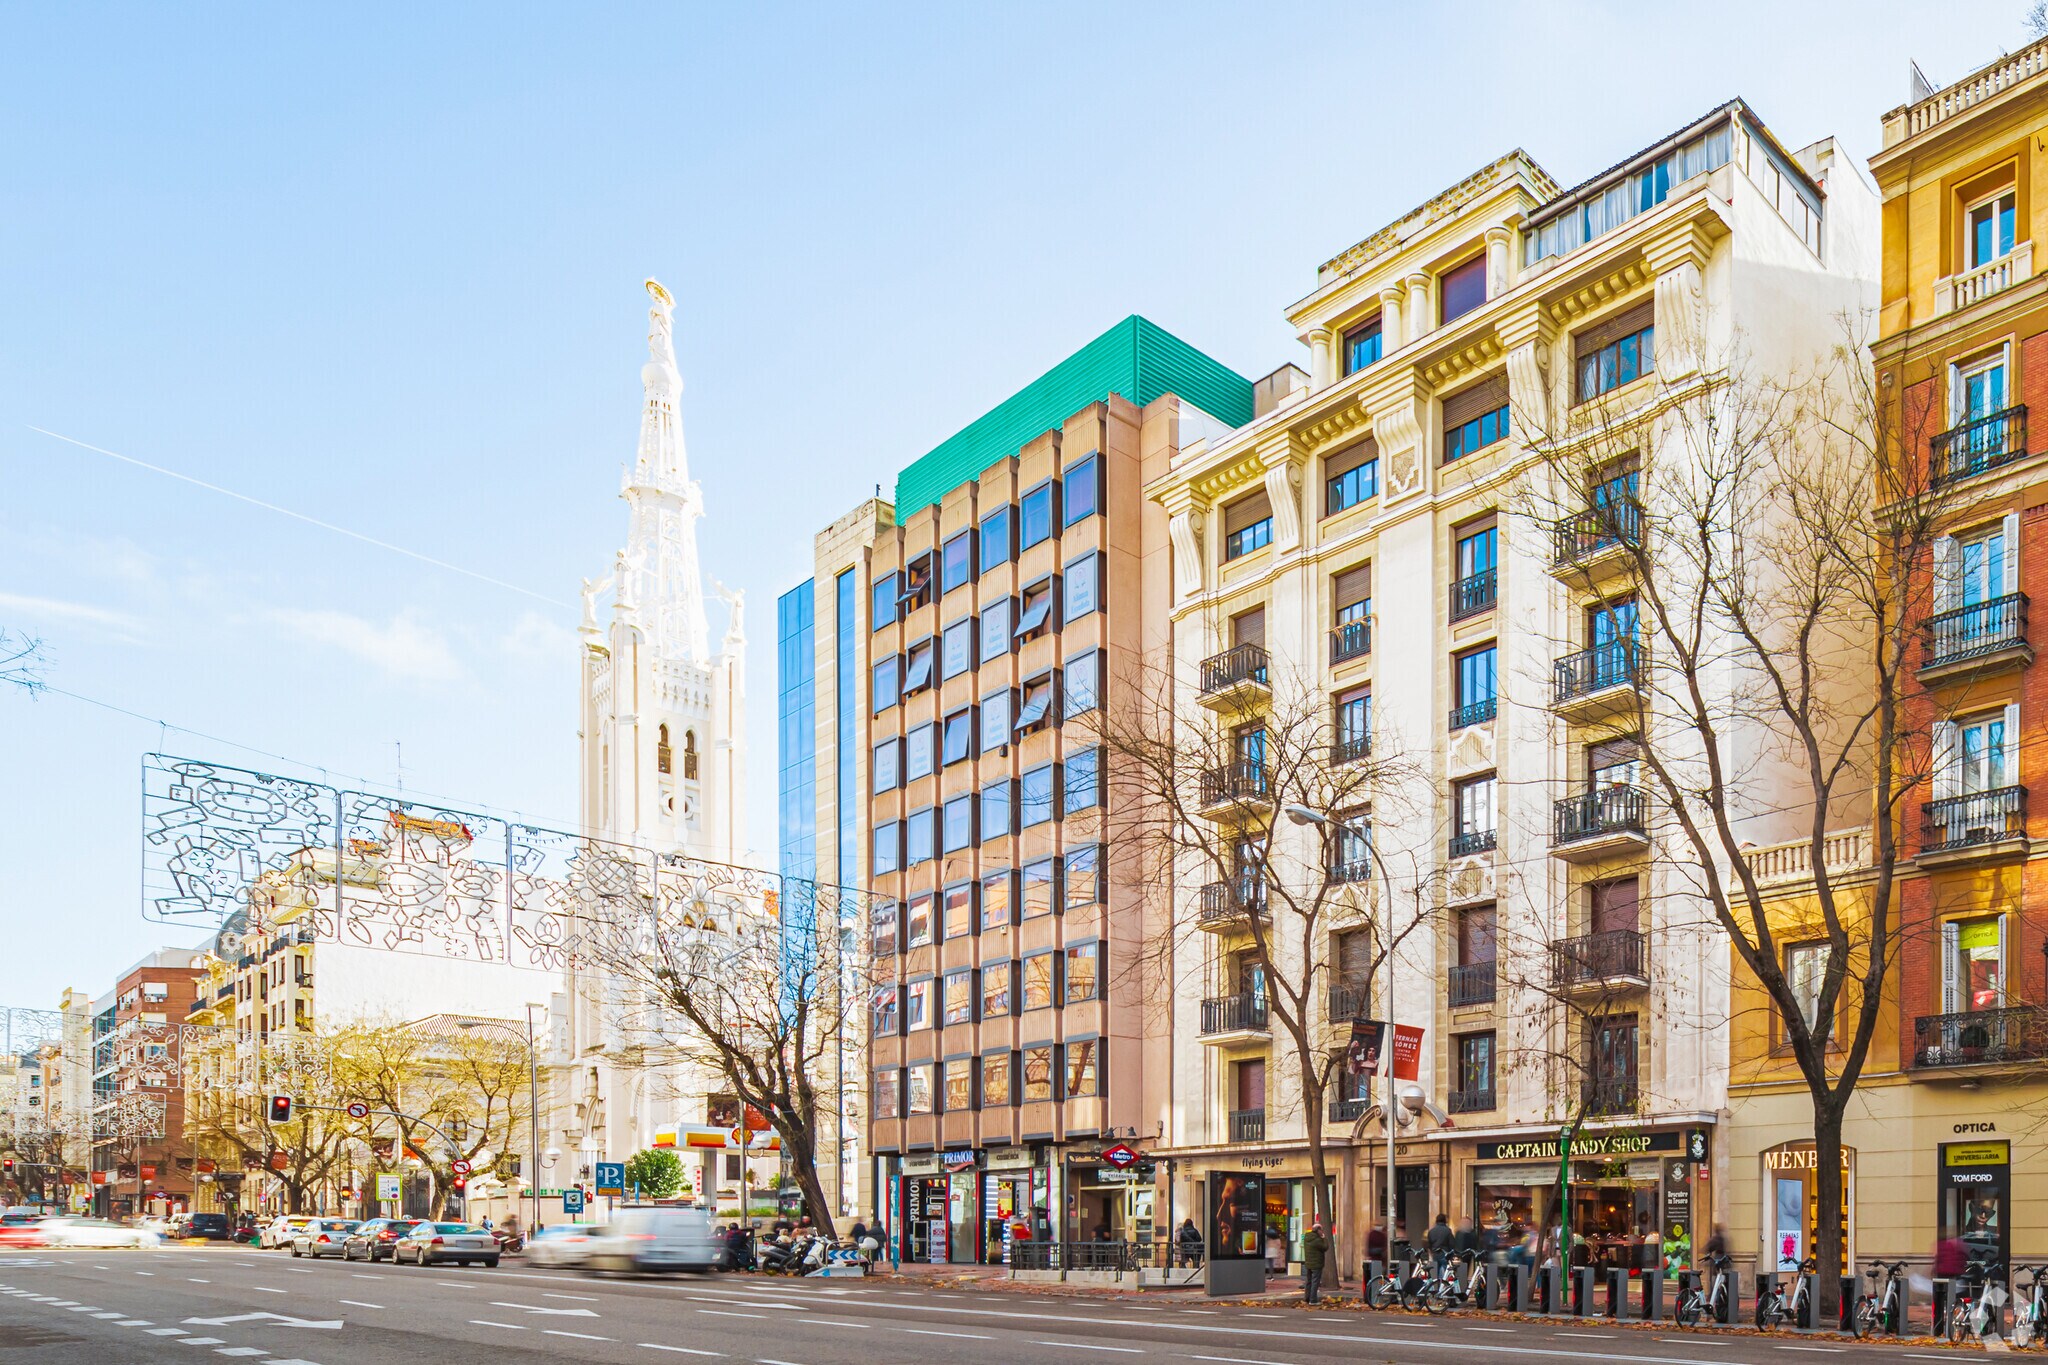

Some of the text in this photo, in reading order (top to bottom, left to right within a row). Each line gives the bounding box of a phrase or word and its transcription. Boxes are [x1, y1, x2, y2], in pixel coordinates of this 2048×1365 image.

[1953, 1122, 1996, 1134] OPTICA
[1396, 1145, 1408, 1156] 20
[1496, 1136, 1652, 1159] CAPTAIN ANDY SHOP
[944, 1150, 975, 1164] PRIMOR
[1242, 1156, 1284, 1169] flying tiger
[1764, 1149, 1850, 1170] MENBR
[603, 1167, 619, 1185] P
[1952, 1173, 1993, 1182] TOM FORD
[525, 1188, 547, 1196] FLES
[910, 1178, 919, 1222] PRIMOR
